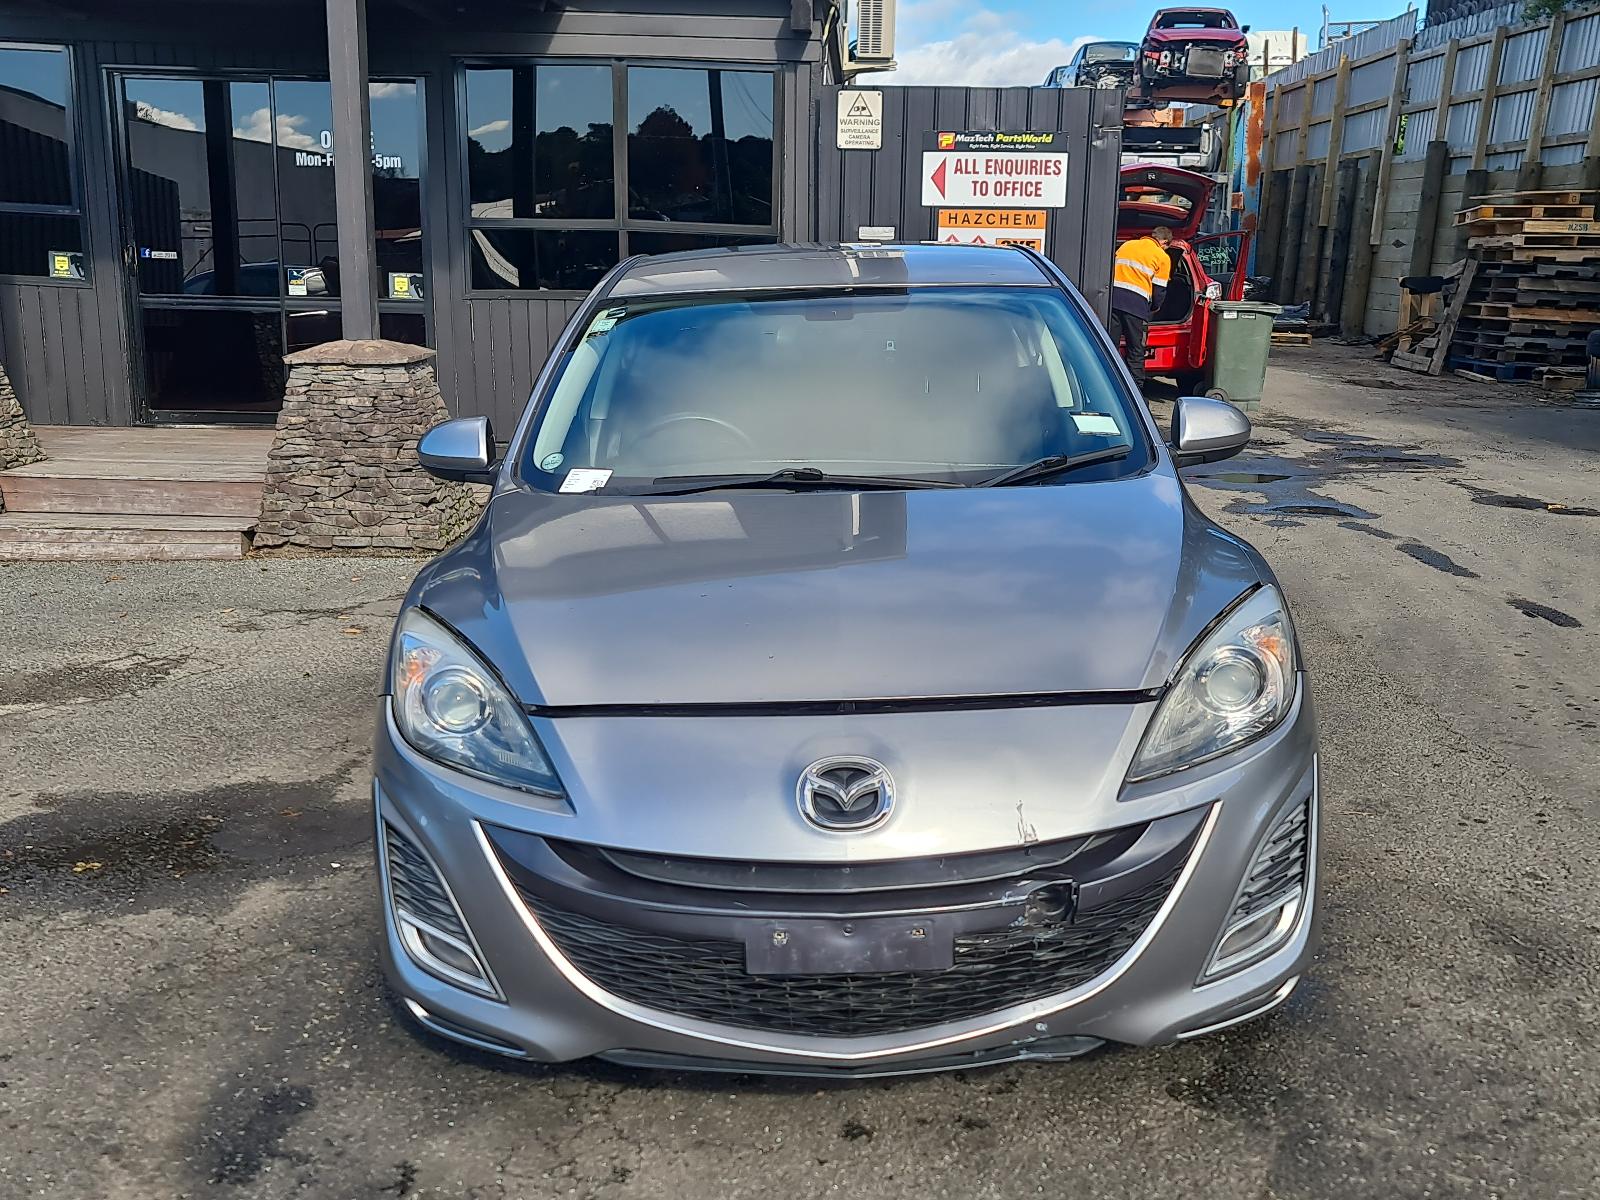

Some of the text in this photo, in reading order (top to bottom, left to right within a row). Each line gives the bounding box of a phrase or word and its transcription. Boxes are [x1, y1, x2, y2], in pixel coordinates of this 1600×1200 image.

[840, 118, 880, 126] WARNING
[955, 133, 1053, 143] MazTech PartsWorld
[954, 158, 1062, 177] ALL ENQUIRIES
[971, 180, 1043, 198] TO OFFICE
[948, 212, 1037, 226] HAZCHEM
